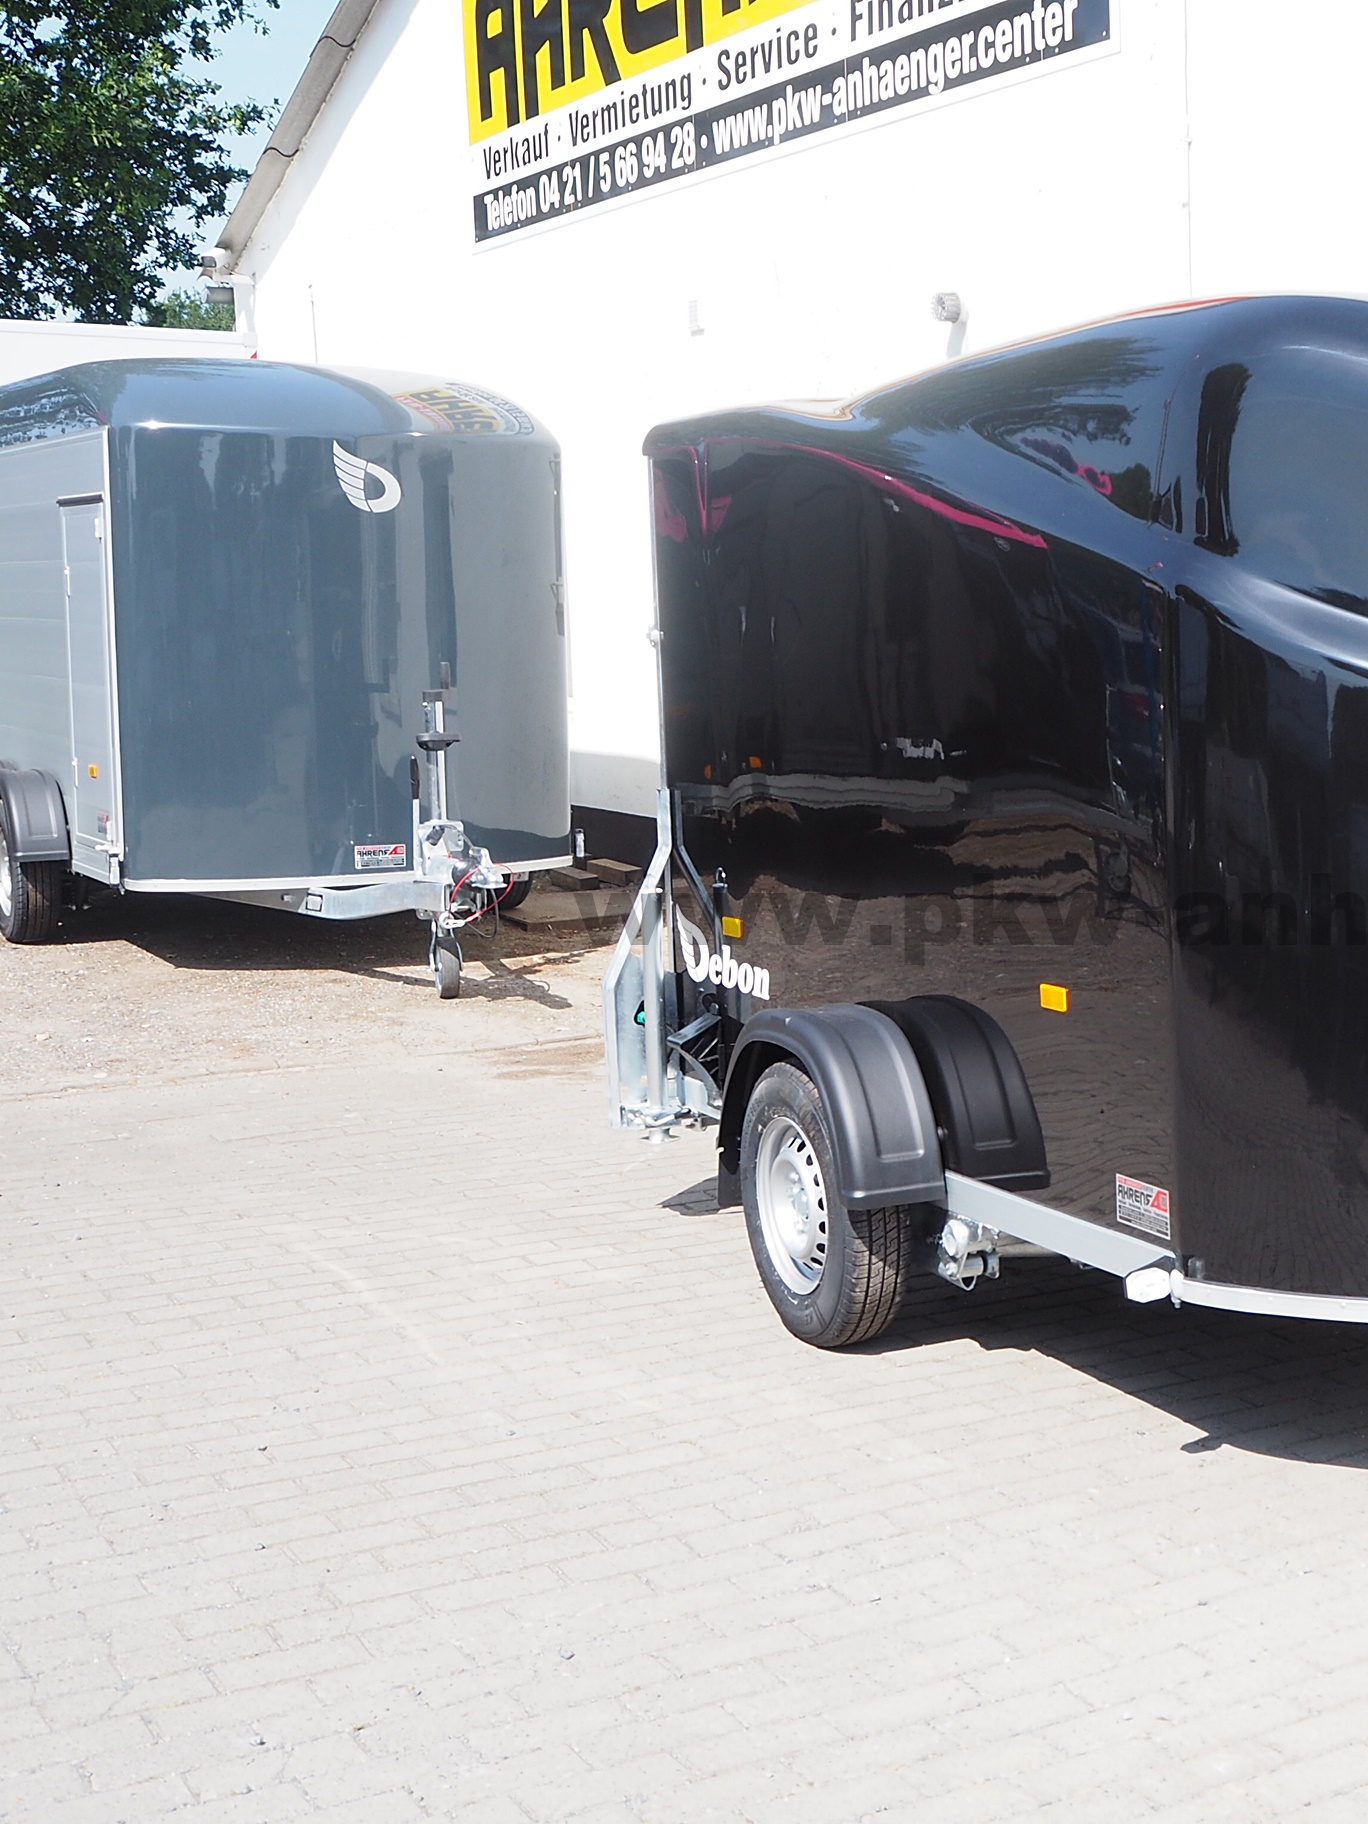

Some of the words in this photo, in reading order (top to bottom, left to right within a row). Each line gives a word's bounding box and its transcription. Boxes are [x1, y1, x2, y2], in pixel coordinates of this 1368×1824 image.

[483, 122, 550, 181] Verkauf
[568, 73, 692, 147] Vermietung
[717, 23, 818, 91] Service
[483, 184, 537, 232] Telefon
[600, 151, 612, 193] 5
[615, 141, 639, 188] 66
[641, 131, 667, 179] 94
[671, 121, 697, 170] 28
[712, 0, 1079, 155] www.pkw-anhaenger.center
[675, 903, 770, 1000] Debon
[1117, 1184, 1153, 1206] AHRENS
